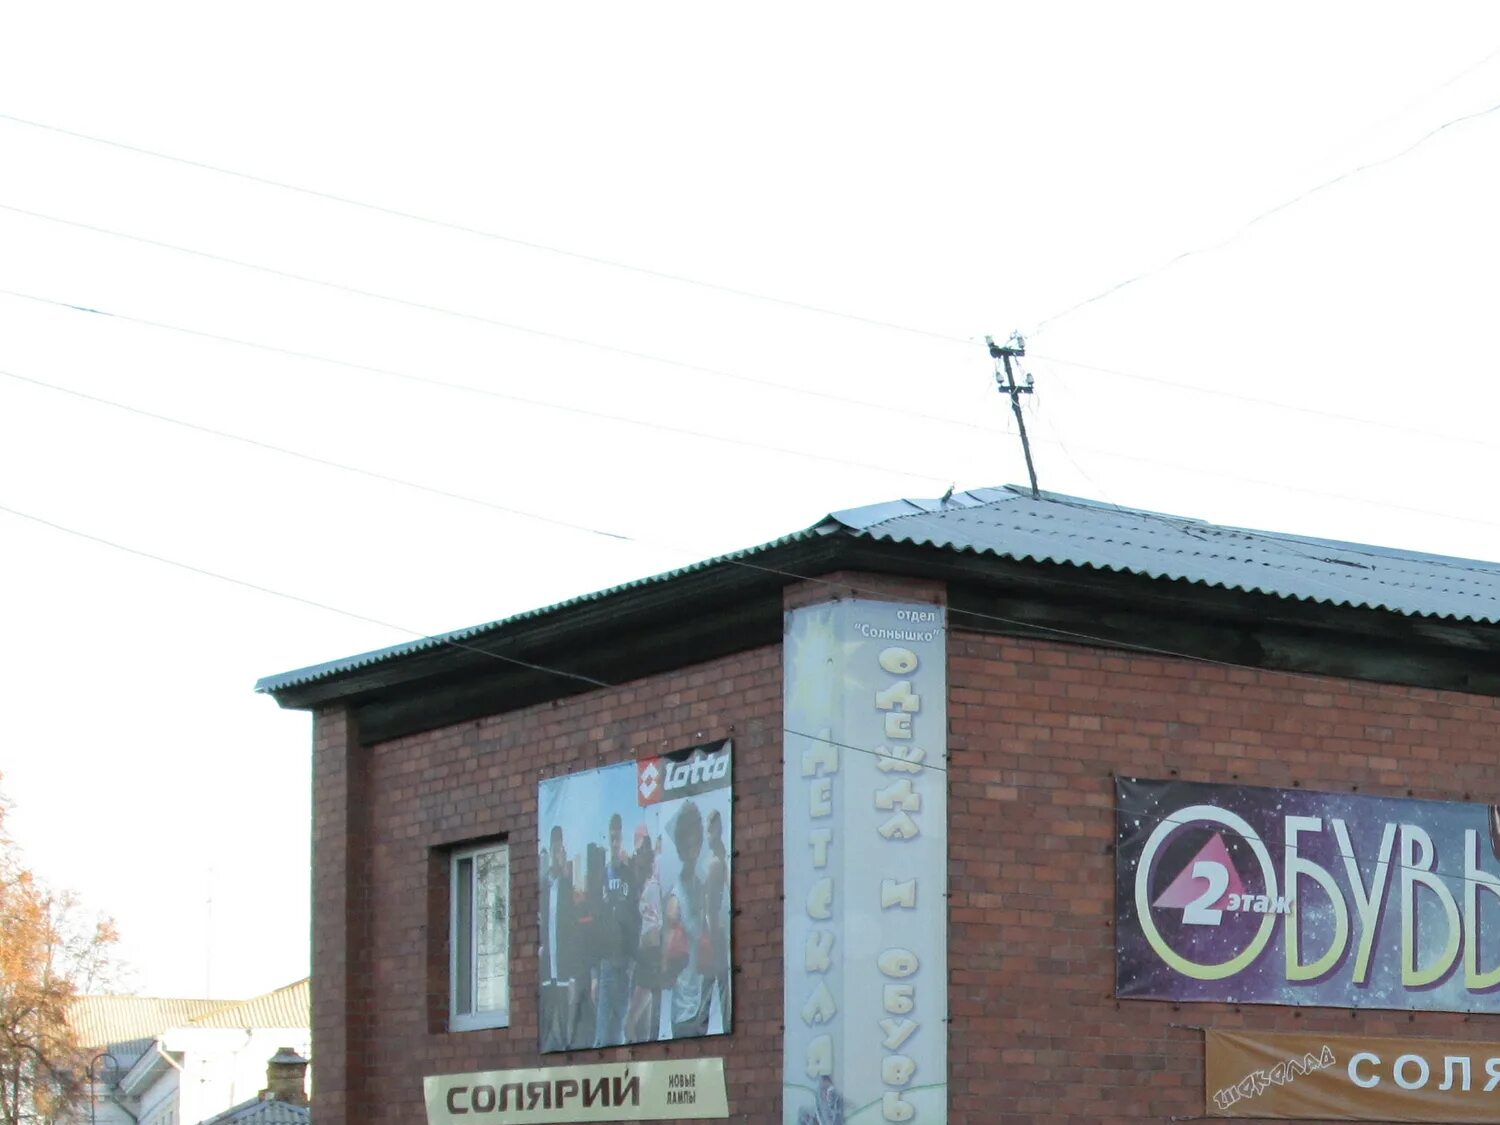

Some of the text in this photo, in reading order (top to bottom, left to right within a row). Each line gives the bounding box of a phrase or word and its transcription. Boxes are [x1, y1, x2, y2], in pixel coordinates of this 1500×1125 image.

[896, 609, 936, 623] отдел
[1181, 860, 1293, 926] 2 этаж
[876, 948, 921, 1123] ОБУВЬ
[446, 1068, 641, 1115] СОЛЯРИЙ
[667, 1073, 696, 1088] НОВЫЕ
[666, 1090, 696, 1105] ЛАМПЫ
